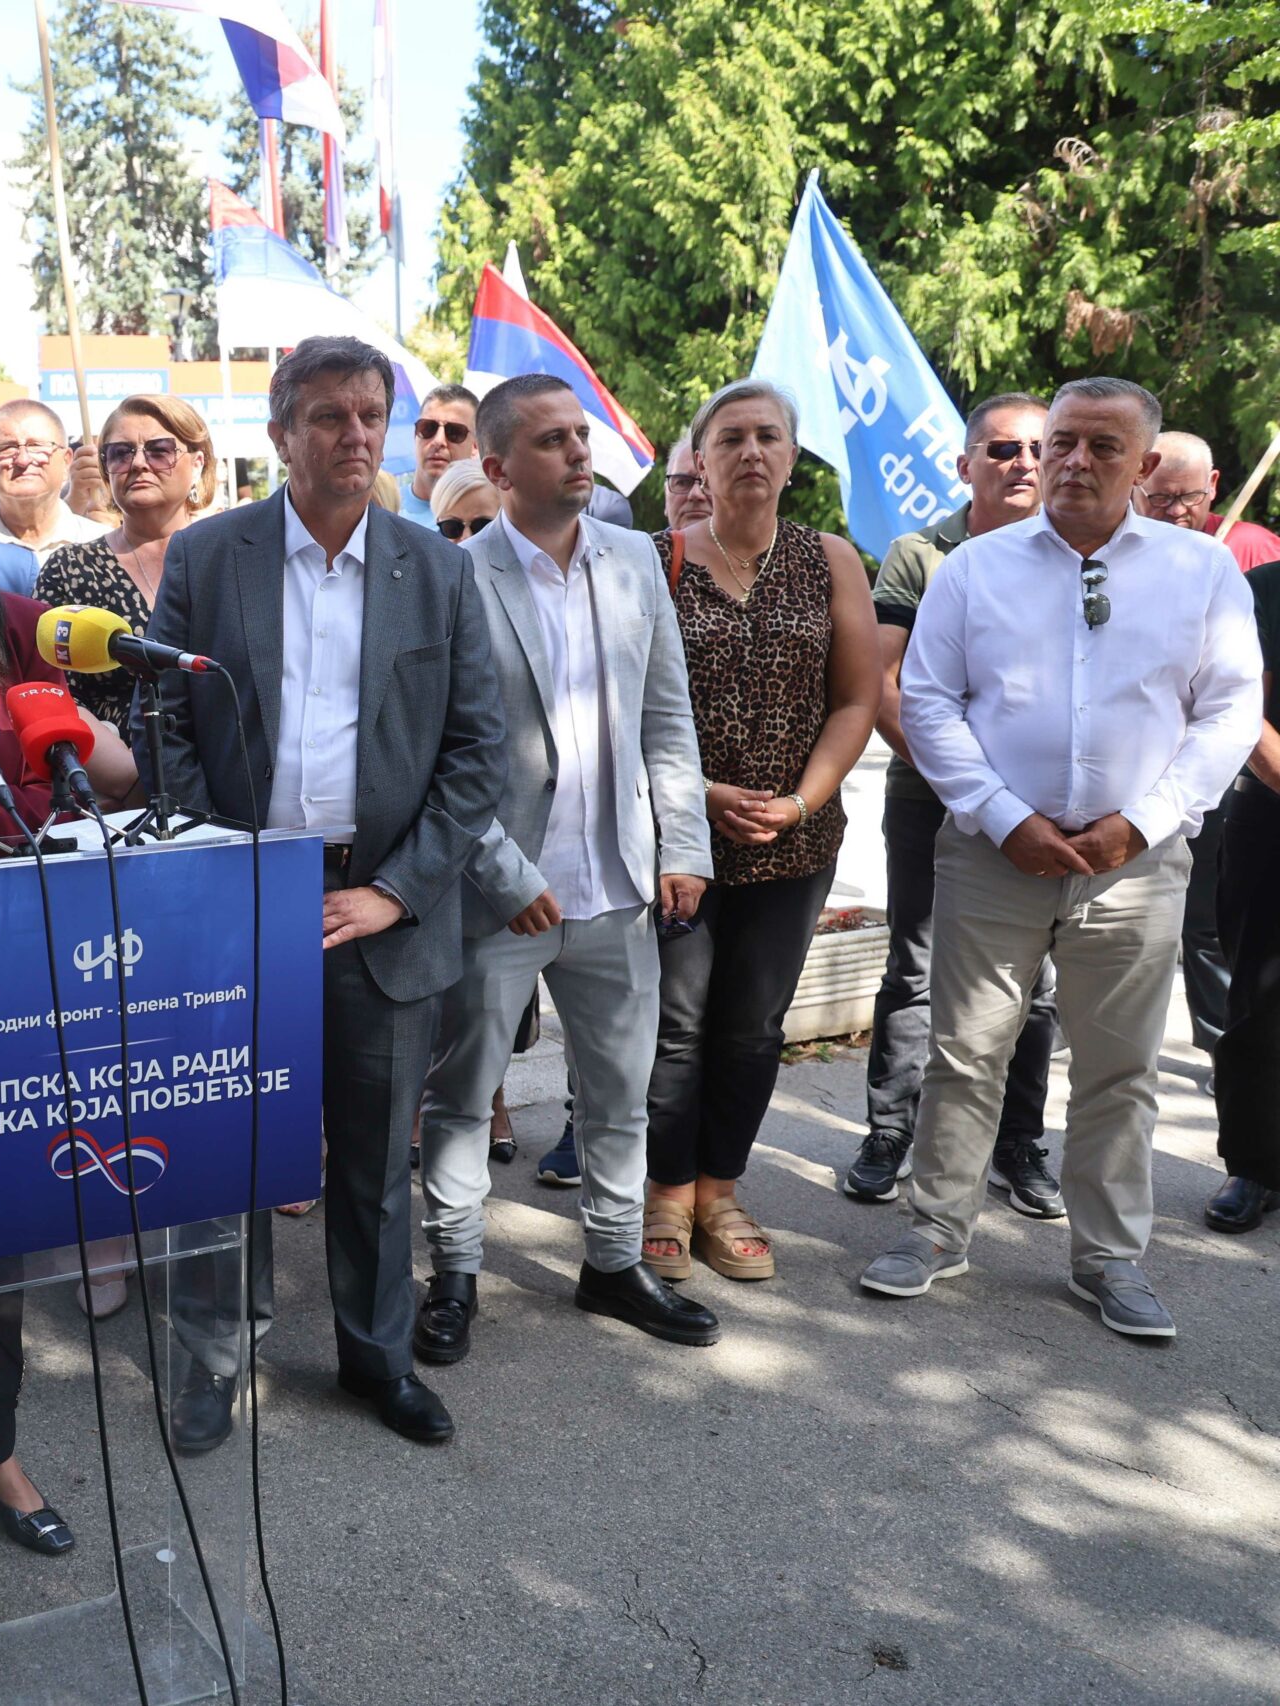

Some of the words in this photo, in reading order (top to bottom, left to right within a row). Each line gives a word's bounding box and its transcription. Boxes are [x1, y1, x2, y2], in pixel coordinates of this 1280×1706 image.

[183, 985, 247, 1009] Тривић
[90, 1059, 165, 1091] КОЈА
[173, 1045, 249, 1077] РАДИ
[47, 1095, 123, 1127] КОЈА
[130, 1068, 290, 1114] ПОБЈЕЂУЈЕ
